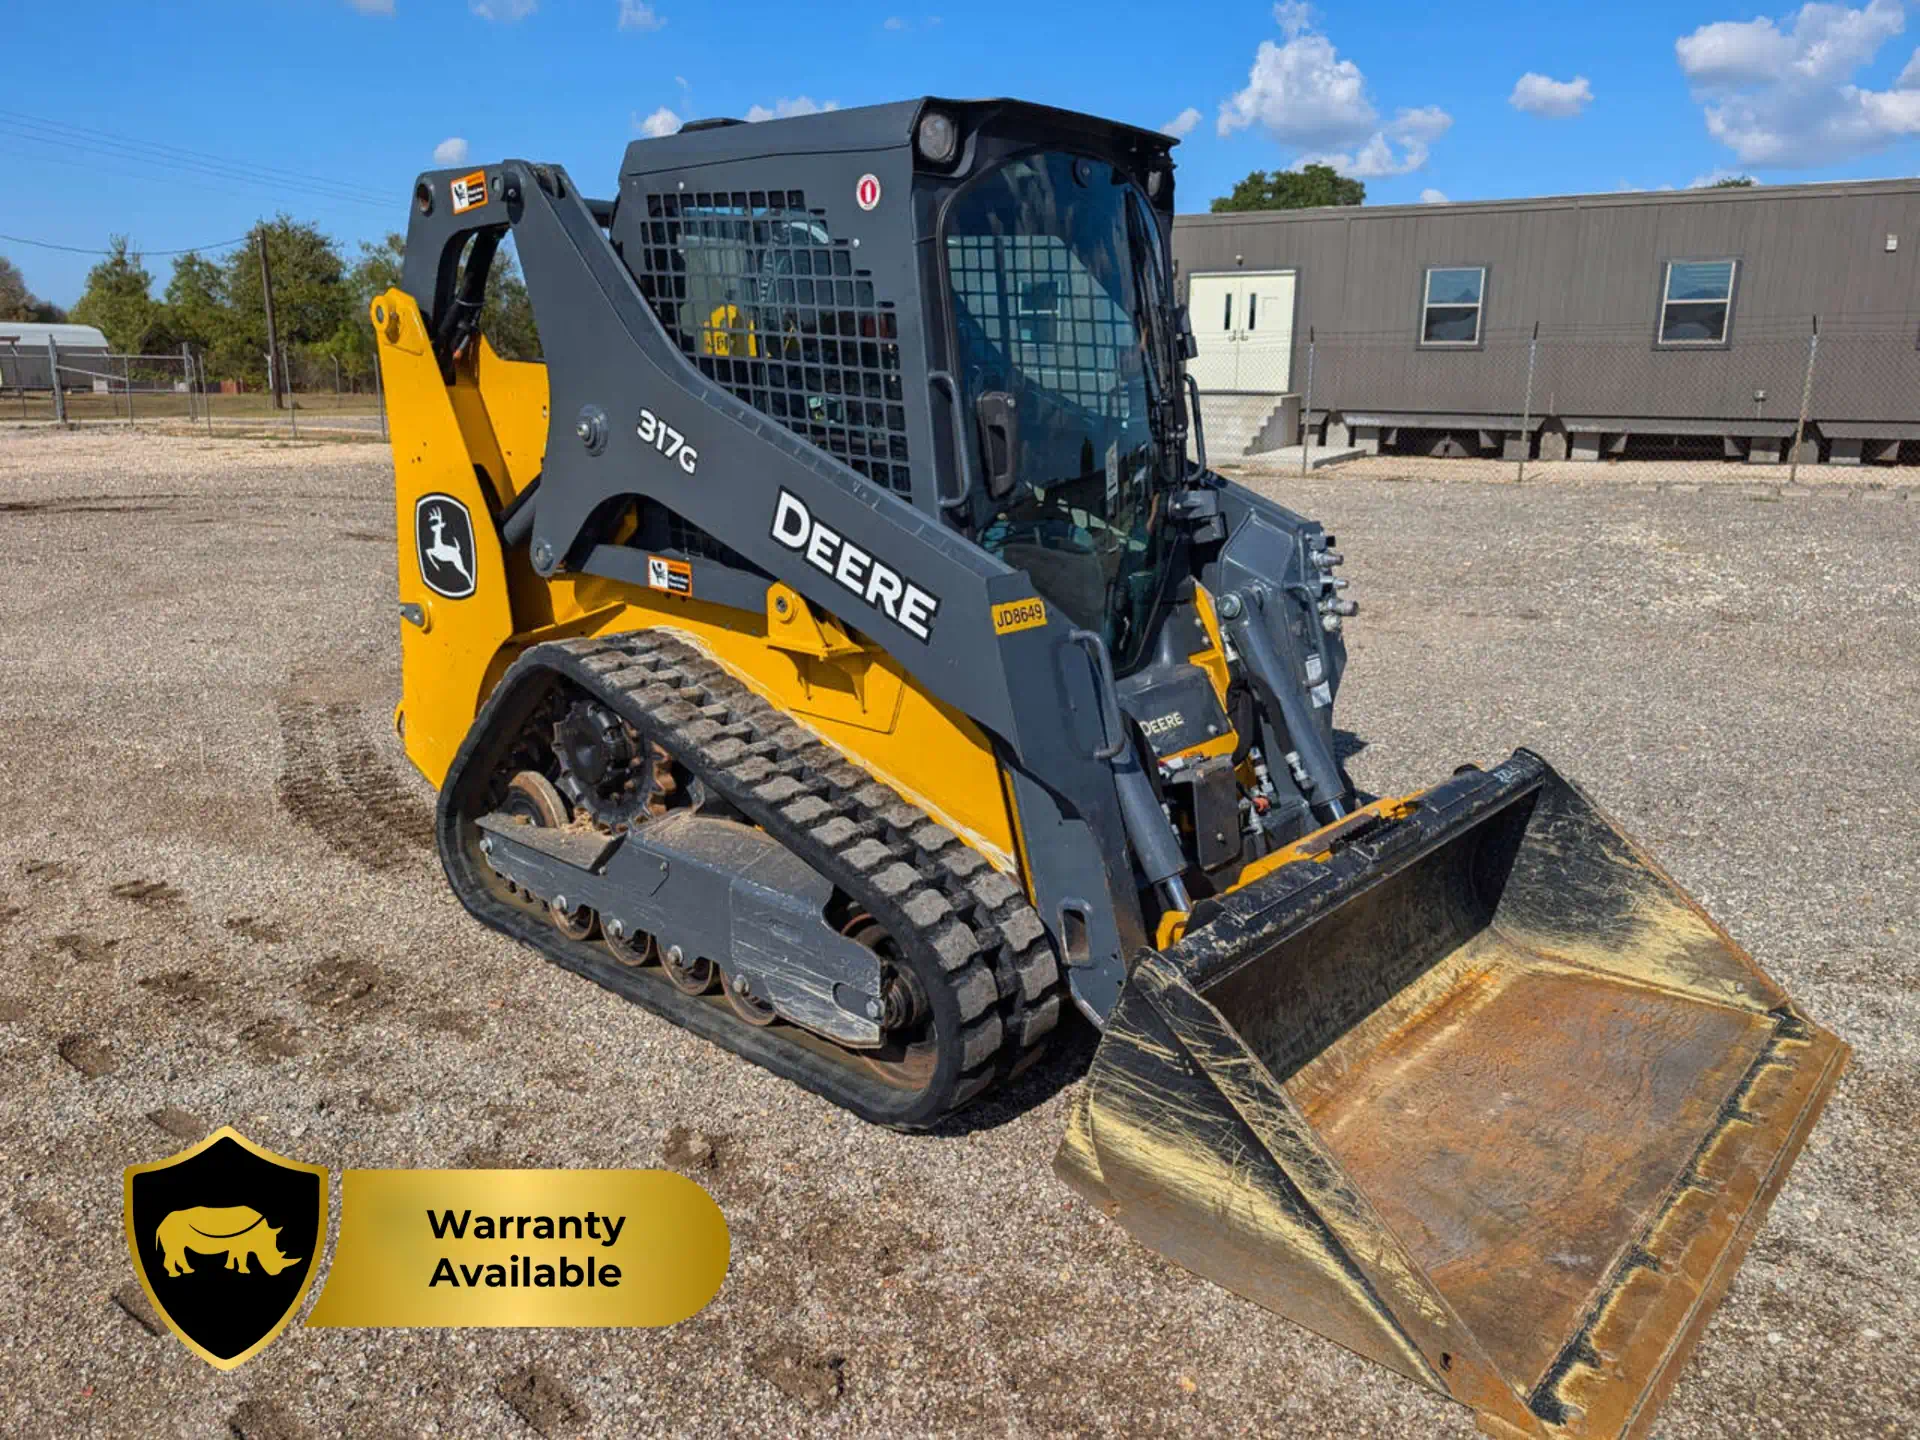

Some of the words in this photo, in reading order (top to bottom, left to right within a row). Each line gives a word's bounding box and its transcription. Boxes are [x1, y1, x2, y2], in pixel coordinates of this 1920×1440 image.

[636, 408, 699, 474] 317G
[771, 489, 939, 641] DEERE
[997, 603, 1043, 628] JD8649
[1140, 711, 1184, 737] DEERE
